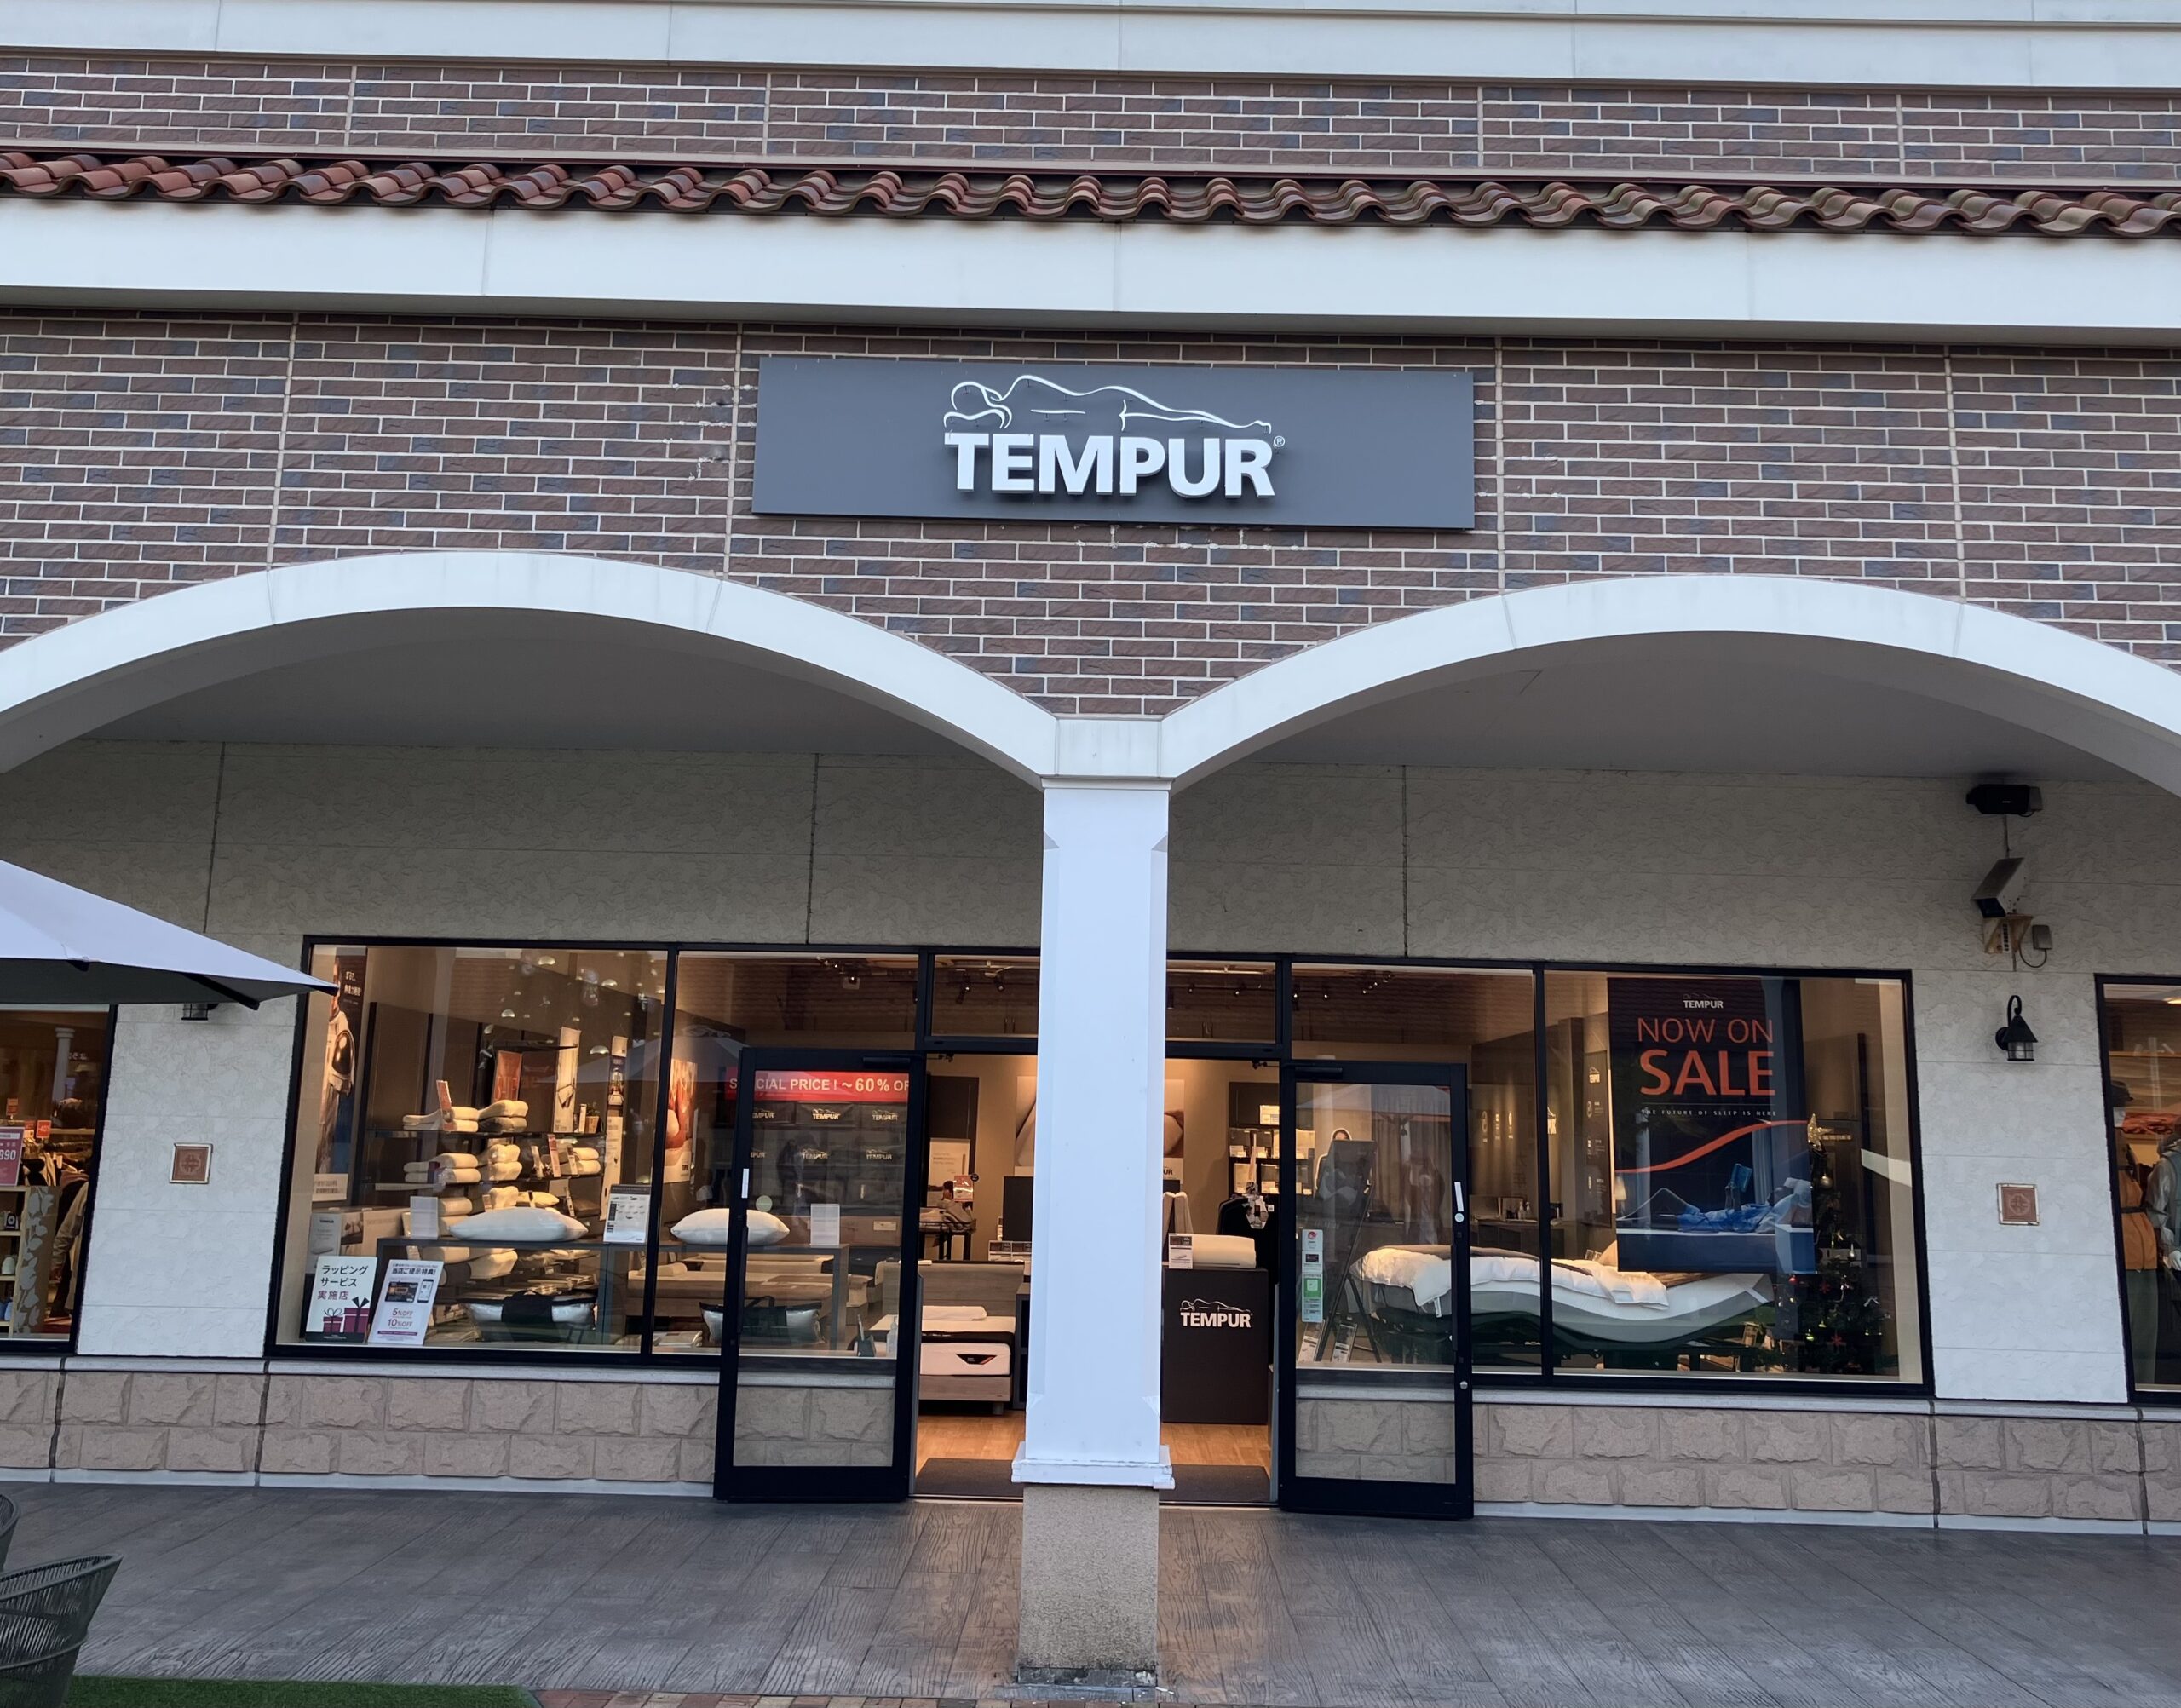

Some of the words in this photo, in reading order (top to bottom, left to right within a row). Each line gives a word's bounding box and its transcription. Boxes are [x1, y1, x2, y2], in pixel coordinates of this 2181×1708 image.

[944, 432, 1275, 498] TEMPUR
[1683, 999, 1724, 1009] TEMPUR
[1637, 1017, 1715, 1044] NOW
[1727, 1018, 1773, 1044] ON
[1639, 1049, 1775, 1096] SALE
[321, 1265, 369, 1275] ラッピング
[320, 1278, 357, 1287] サービス
[317, 1290, 349, 1301] 実施店
[1180, 1312, 1252, 1328] TEMPUR
